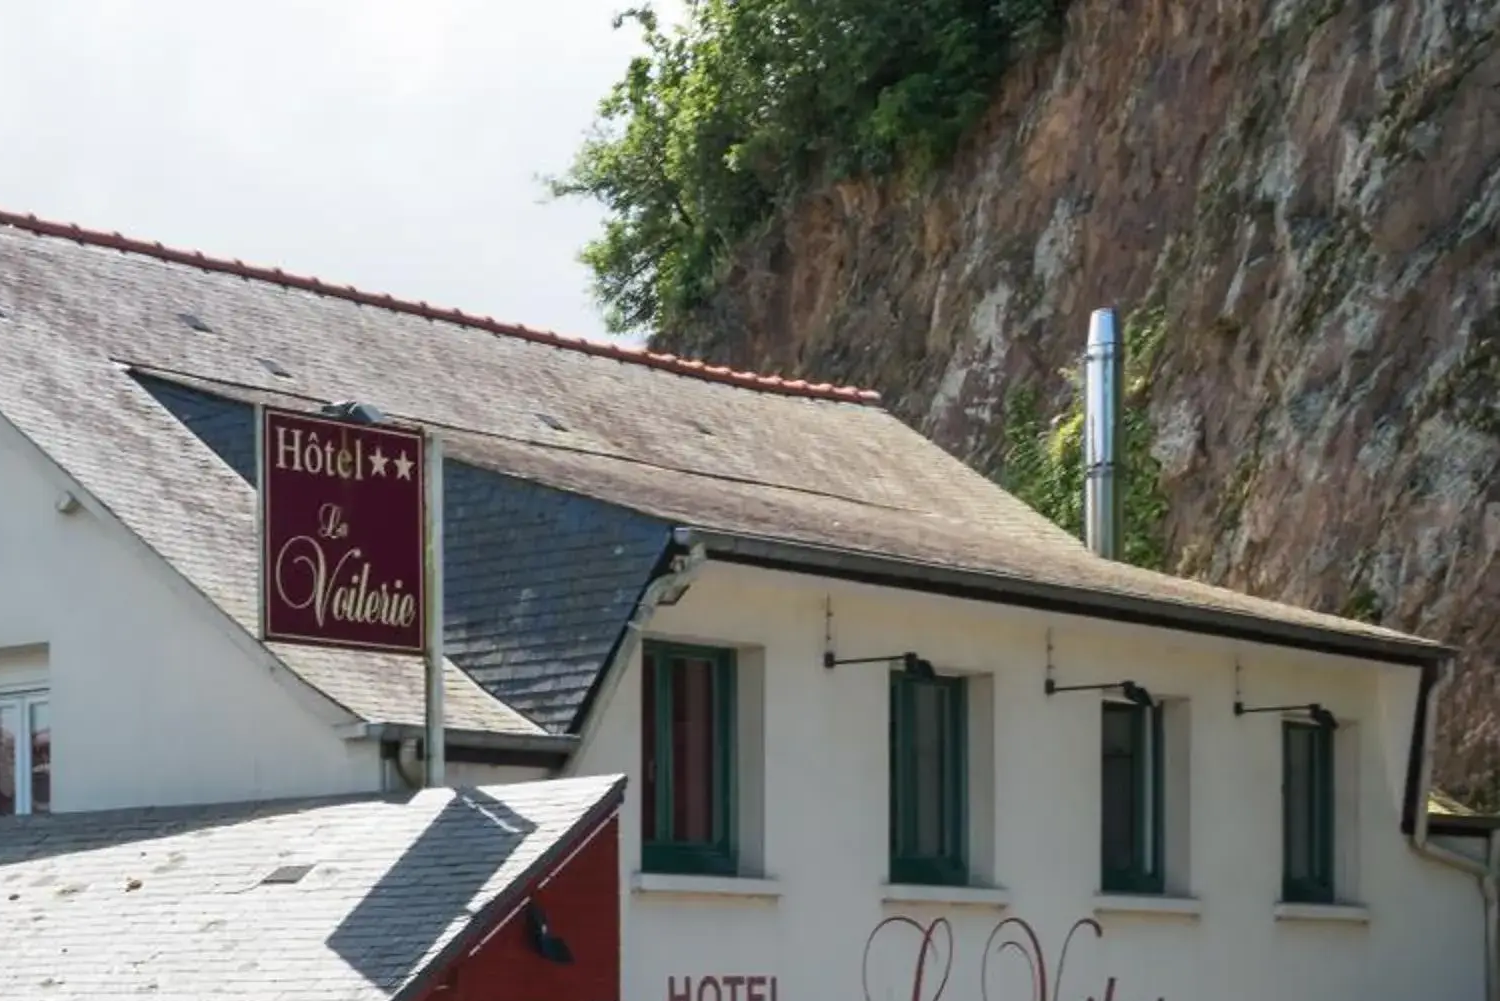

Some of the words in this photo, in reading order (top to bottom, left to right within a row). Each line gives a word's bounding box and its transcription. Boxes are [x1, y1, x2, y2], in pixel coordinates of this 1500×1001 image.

[275, 427, 363, 480] Hôtel
[318, 503, 348, 538] La
[276, 535, 415, 627] Voilerie
